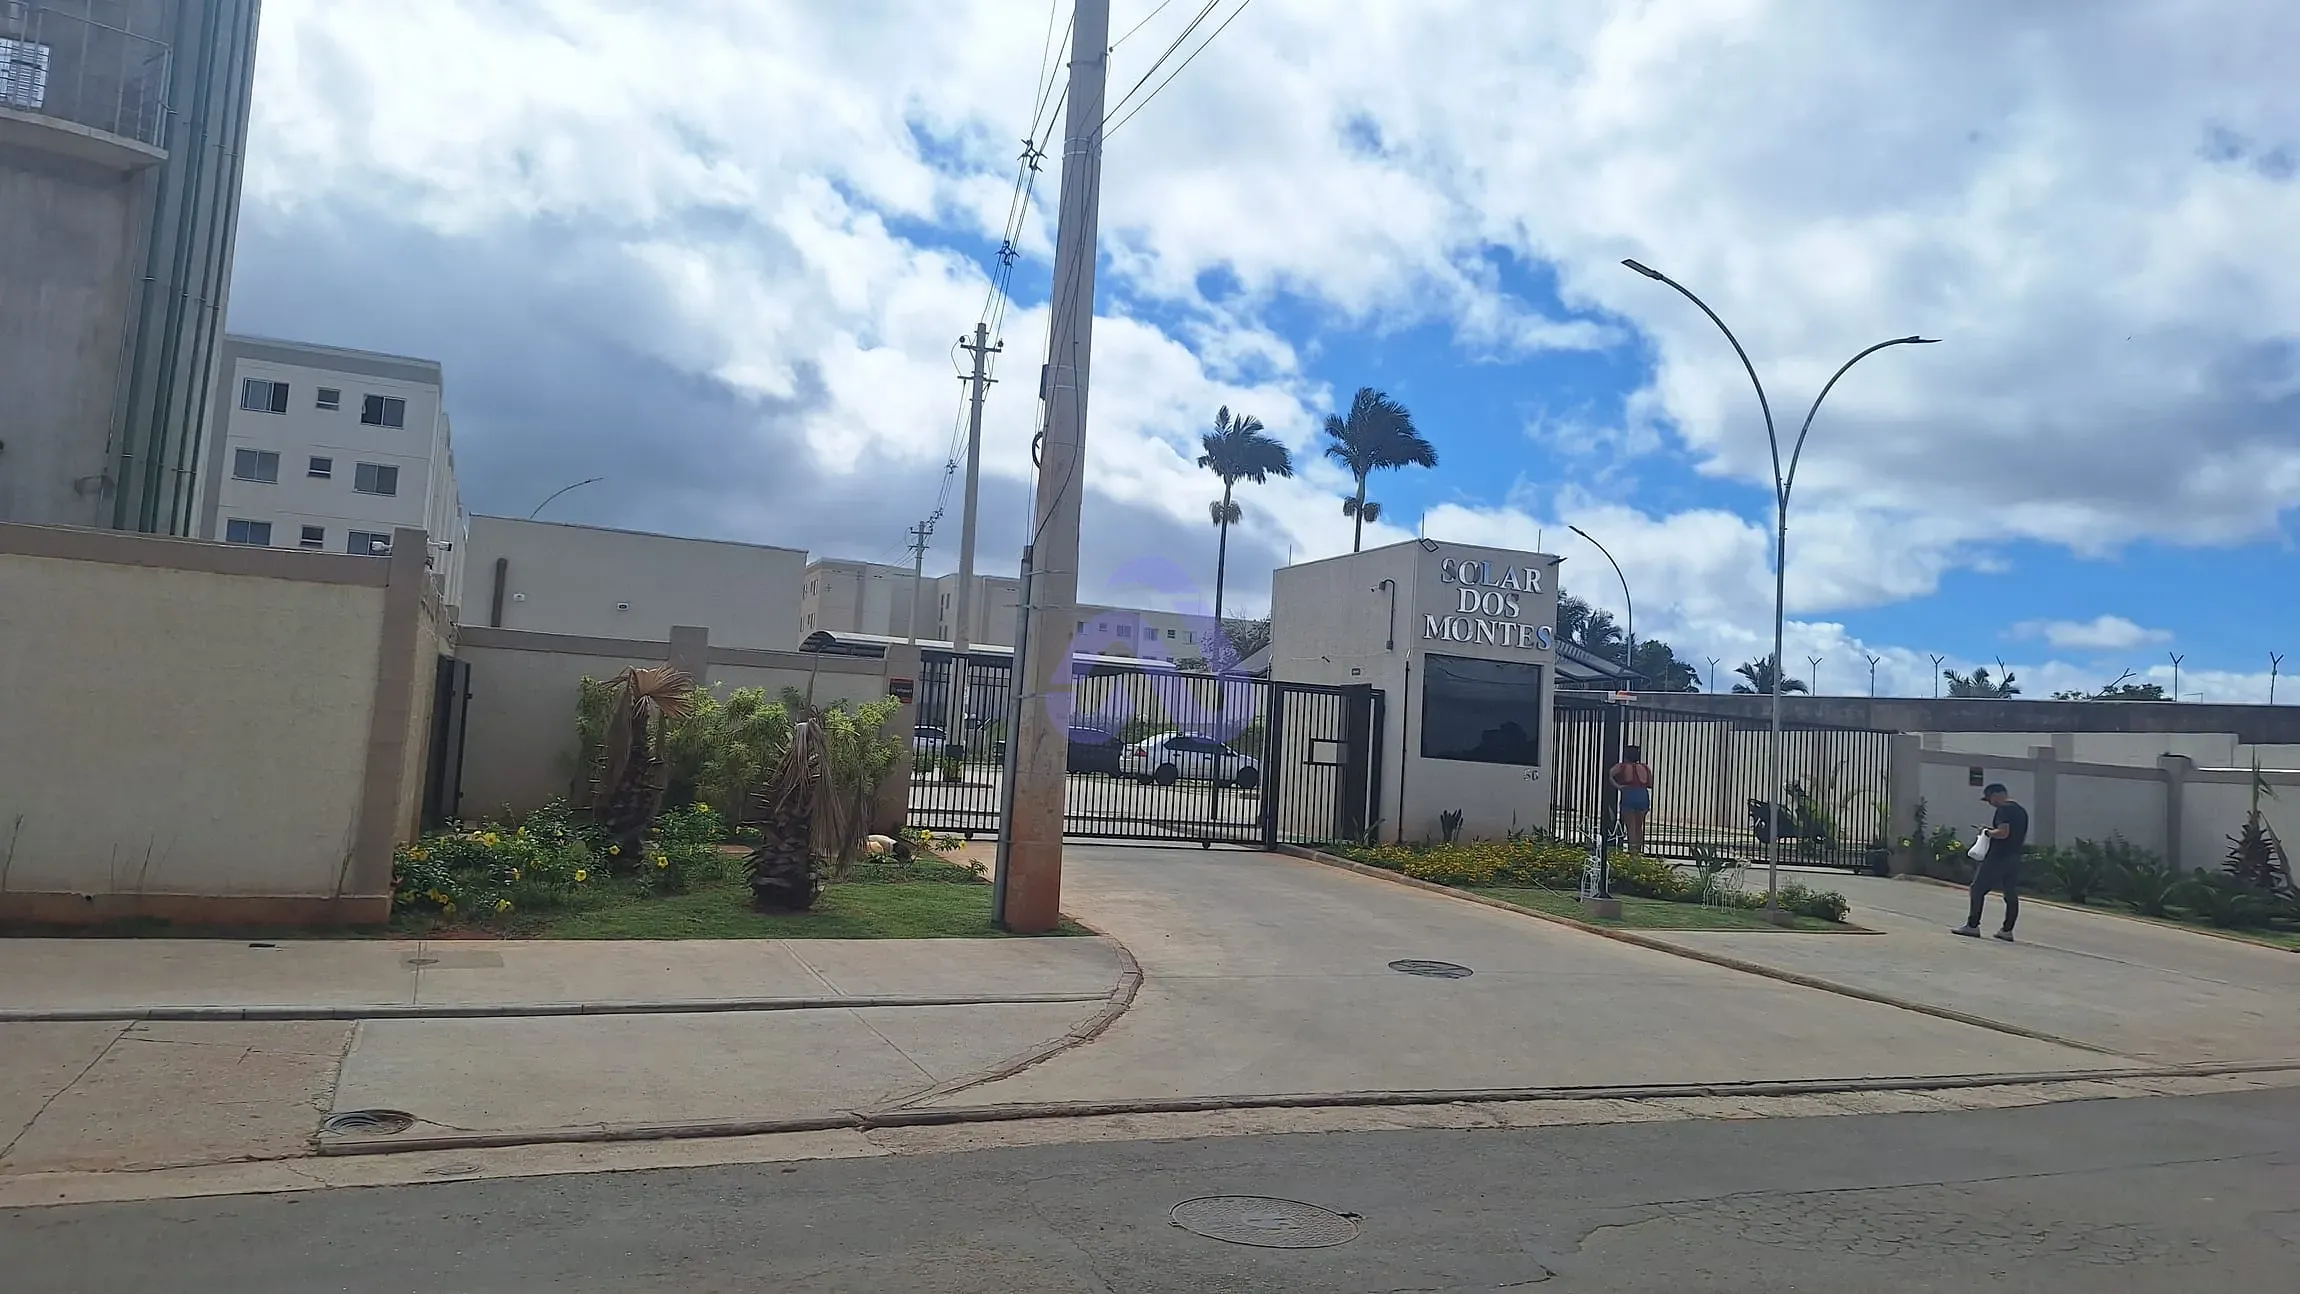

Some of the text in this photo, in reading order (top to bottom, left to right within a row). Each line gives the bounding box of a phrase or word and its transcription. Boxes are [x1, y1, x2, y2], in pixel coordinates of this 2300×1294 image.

[1441, 557, 1542, 593] SOLAR
[1456, 587, 1520, 618] DOS
[1423, 613, 1553, 650] MONTES
